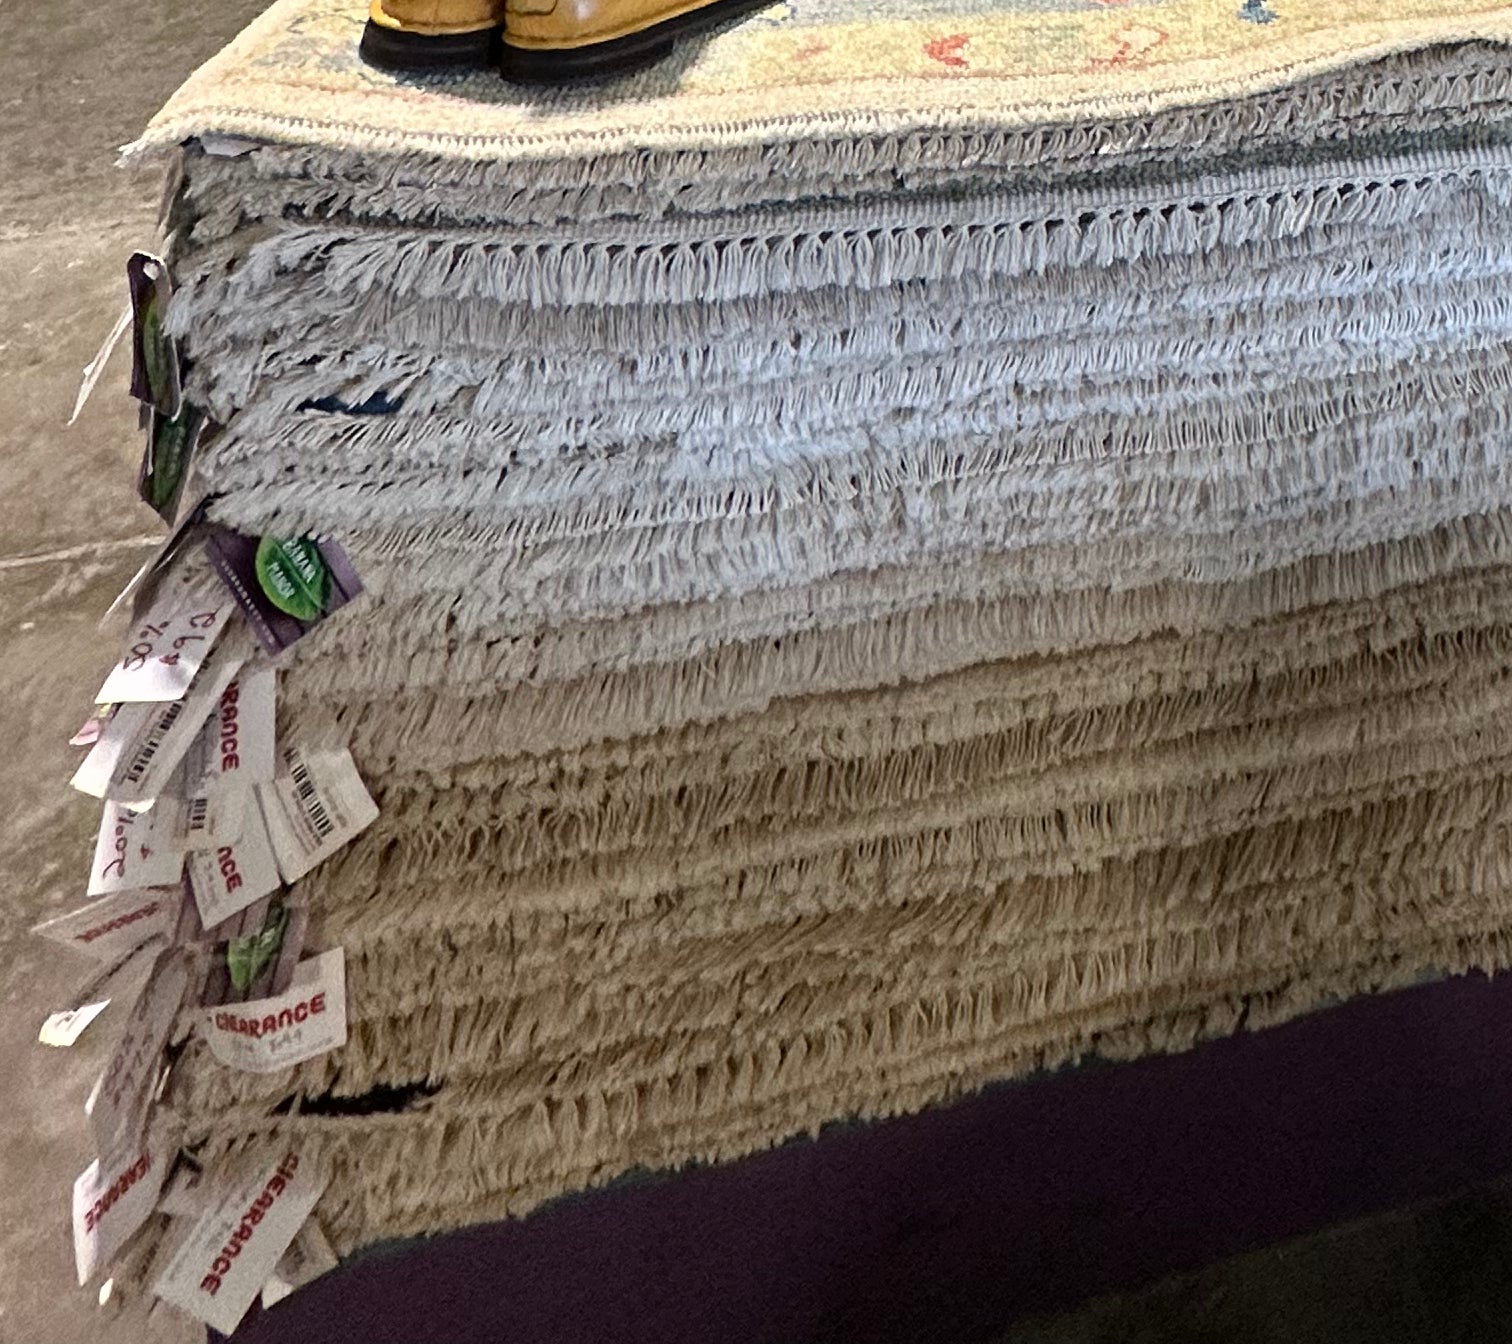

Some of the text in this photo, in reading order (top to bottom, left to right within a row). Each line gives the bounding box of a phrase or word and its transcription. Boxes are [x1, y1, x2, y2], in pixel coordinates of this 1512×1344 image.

[282, 538, 317, 584] BANANA
[215, 992, 326, 1039] CLEARANCE
[200, 1151, 299, 1297] CLEARANCE
